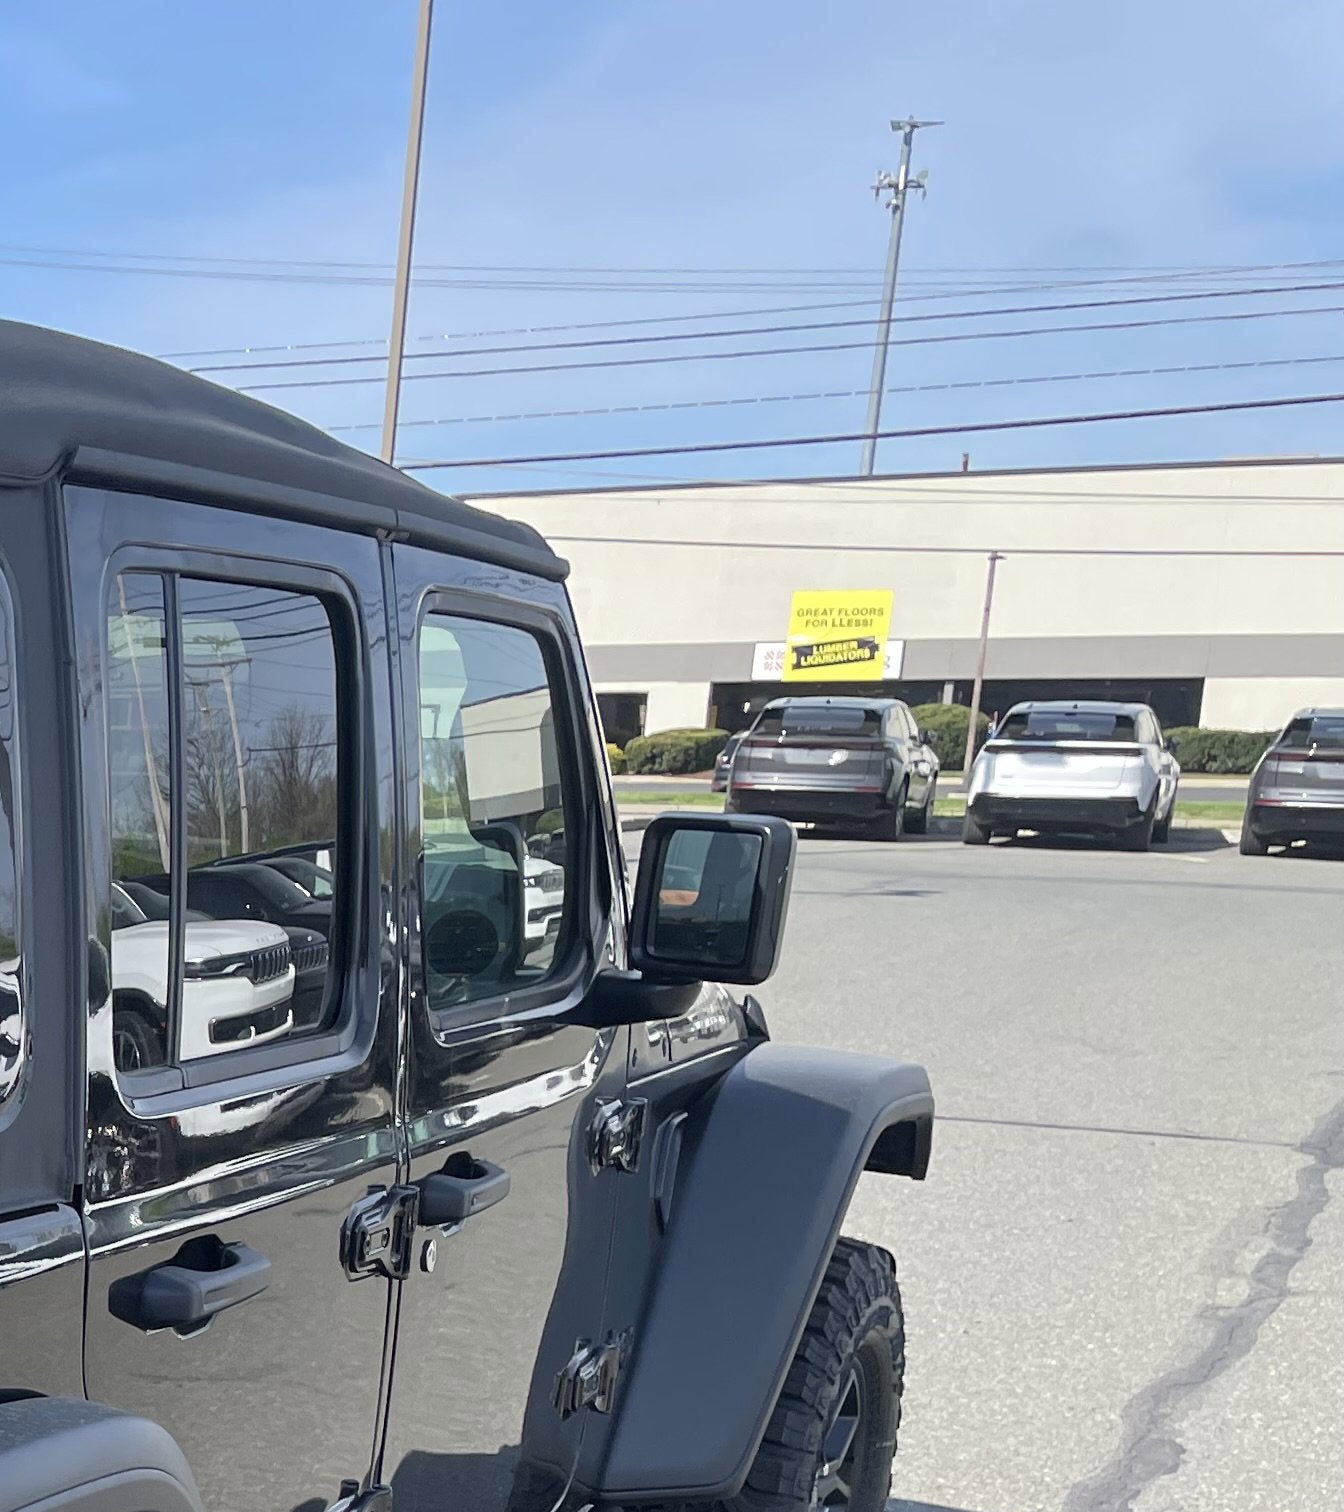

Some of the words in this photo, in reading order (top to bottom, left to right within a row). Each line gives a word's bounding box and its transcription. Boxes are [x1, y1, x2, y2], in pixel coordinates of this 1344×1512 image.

[797, 607, 835, 618] GREAT
[838, 607, 885, 618] FLOORS
[805, 618, 828, 628] FOR
[812, 640, 859, 655] LUMBER
[800, 648, 871, 667] LIQUIDATORS
